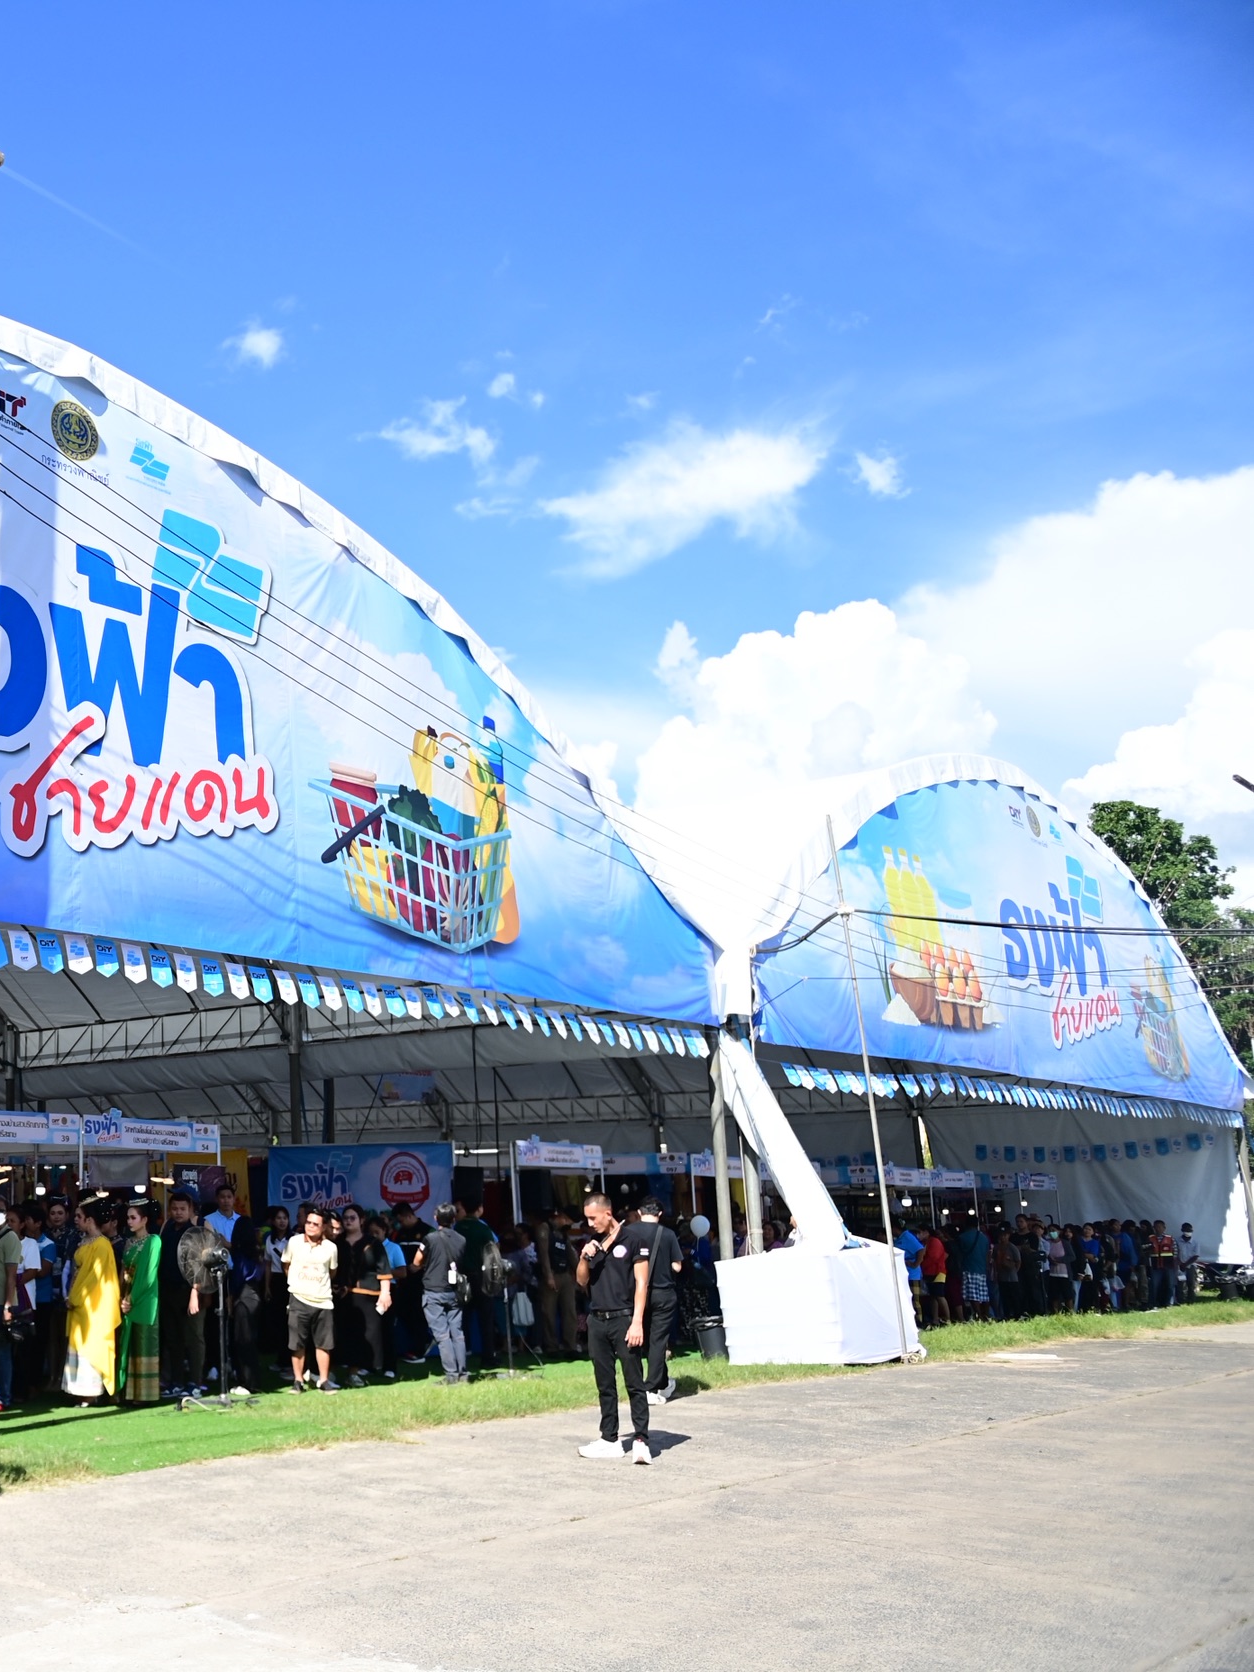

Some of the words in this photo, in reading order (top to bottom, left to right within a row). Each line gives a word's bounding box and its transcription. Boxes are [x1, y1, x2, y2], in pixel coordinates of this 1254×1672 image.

[9, 716, 270, 842] ชายแดน
[1000, 881, 1109, 997] ธงฟ้า
[1052, 972, 1119, 1041] ชายแดน
[85, 1115, 118, 1135] ธงฟ้า
[282, 1163, 346, 1199] ธงฟ้า
